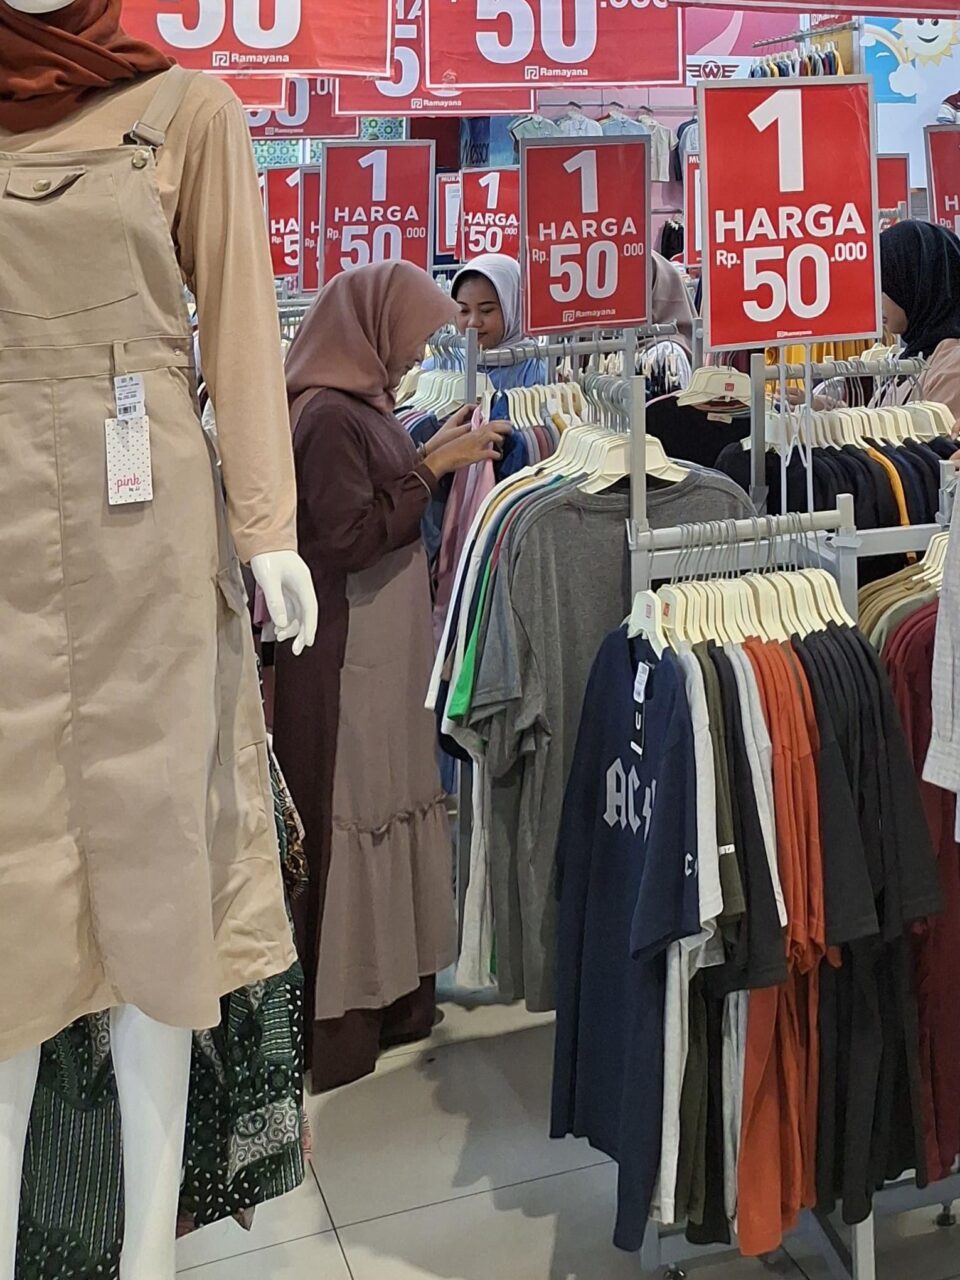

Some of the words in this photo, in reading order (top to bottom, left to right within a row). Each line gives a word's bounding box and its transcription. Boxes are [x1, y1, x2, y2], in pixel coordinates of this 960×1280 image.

[231, 52, 290, 65] Ramayana
[540, 66, 589, 79] Ramayana
[423, 99, 462, 108] Ramayana
[748, 88, 804, 193] 1
[358, 149, 388, 202] 1
[563, 149, 598, 214] 1
[478, 171, 500, 209] 1
[334, 205, 419, 223] HARGA
[463, 211, 518, 226] HARGA
[715, 202, 866, 243] HARGA
[468, 225, 503, 253] 50
[538, 216, 638, 242] HARGA
[339, 223, 402, 270] 50
[531, 248, 550, 264] Rp.
[549, 240, 618, 303] 50
[716, 249, 741, 269] Rp.
[742, 243, 831, 322] 50
[575, 307, 616, 319] Ramayana
[116, 473, 142, 494] pink
